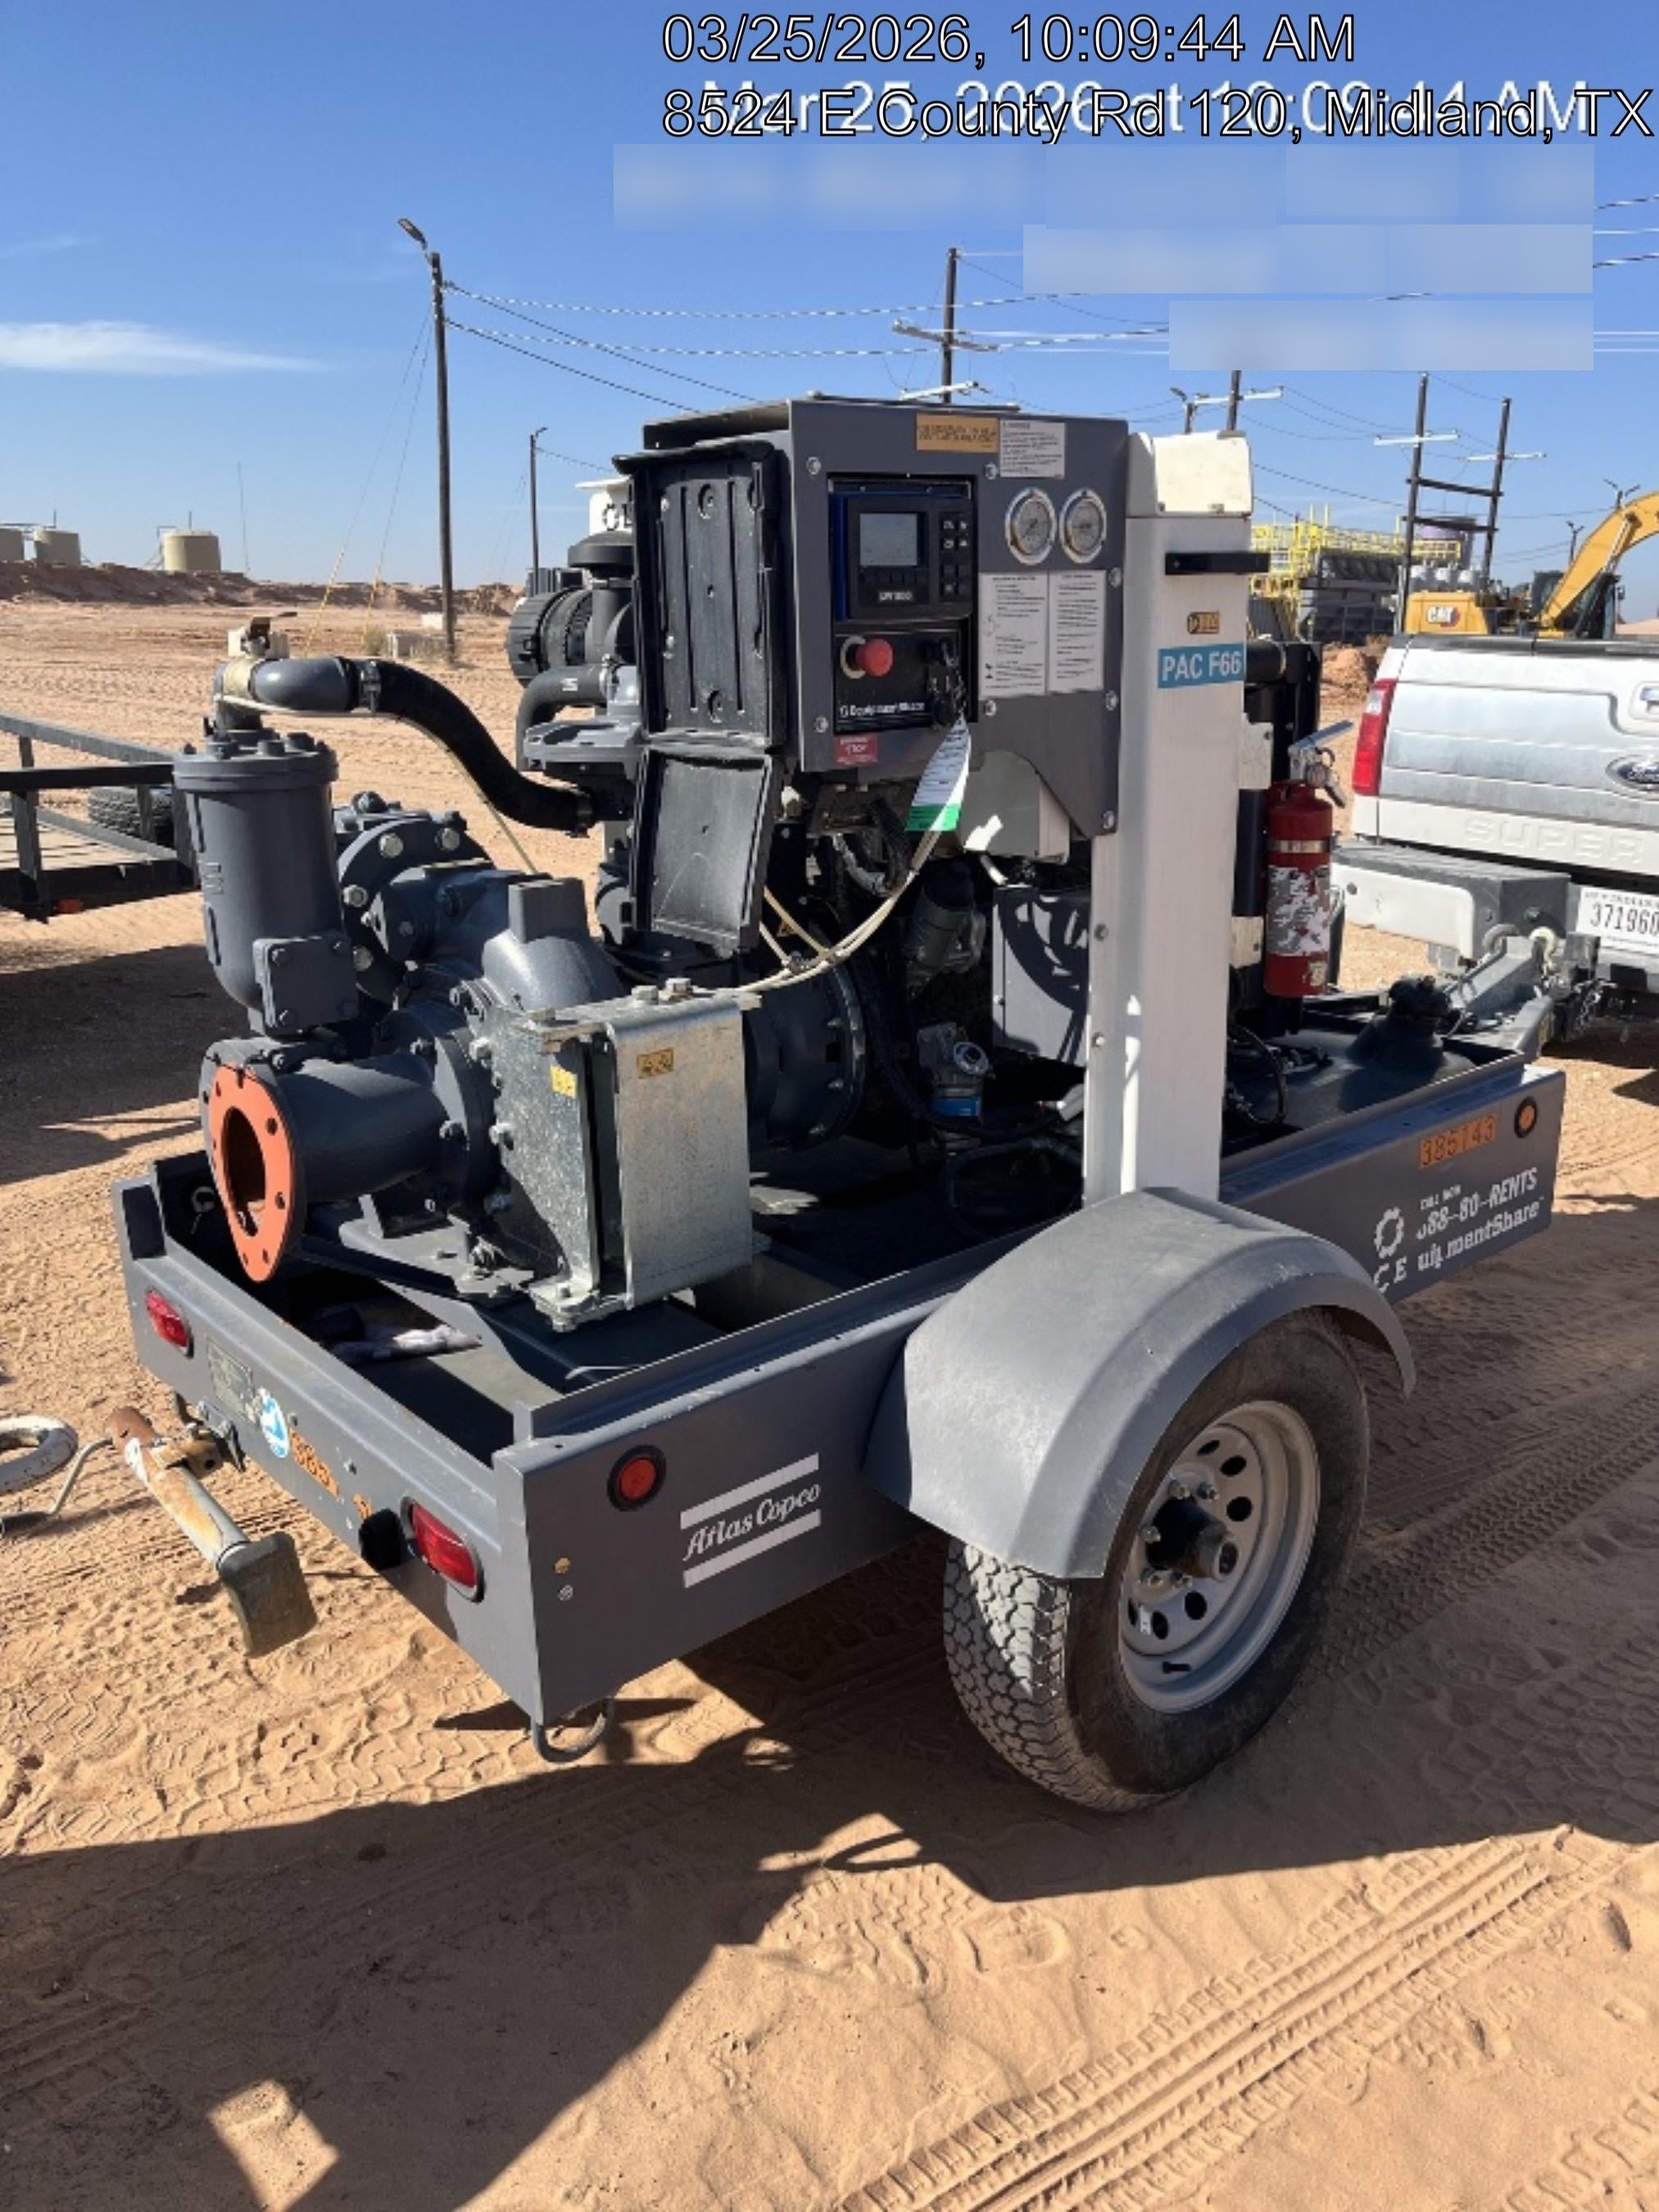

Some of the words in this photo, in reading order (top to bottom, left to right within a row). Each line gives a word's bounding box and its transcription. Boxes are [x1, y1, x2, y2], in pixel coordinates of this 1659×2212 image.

[1162, 653, 1203, 682] PAC
[1208, 650, 1244, 678] F66
[1465, 816, 1645, 863] SUPER
[682, 1513, 754, 1562] Atlas
[755, 1484, 821, 1526] Copco
